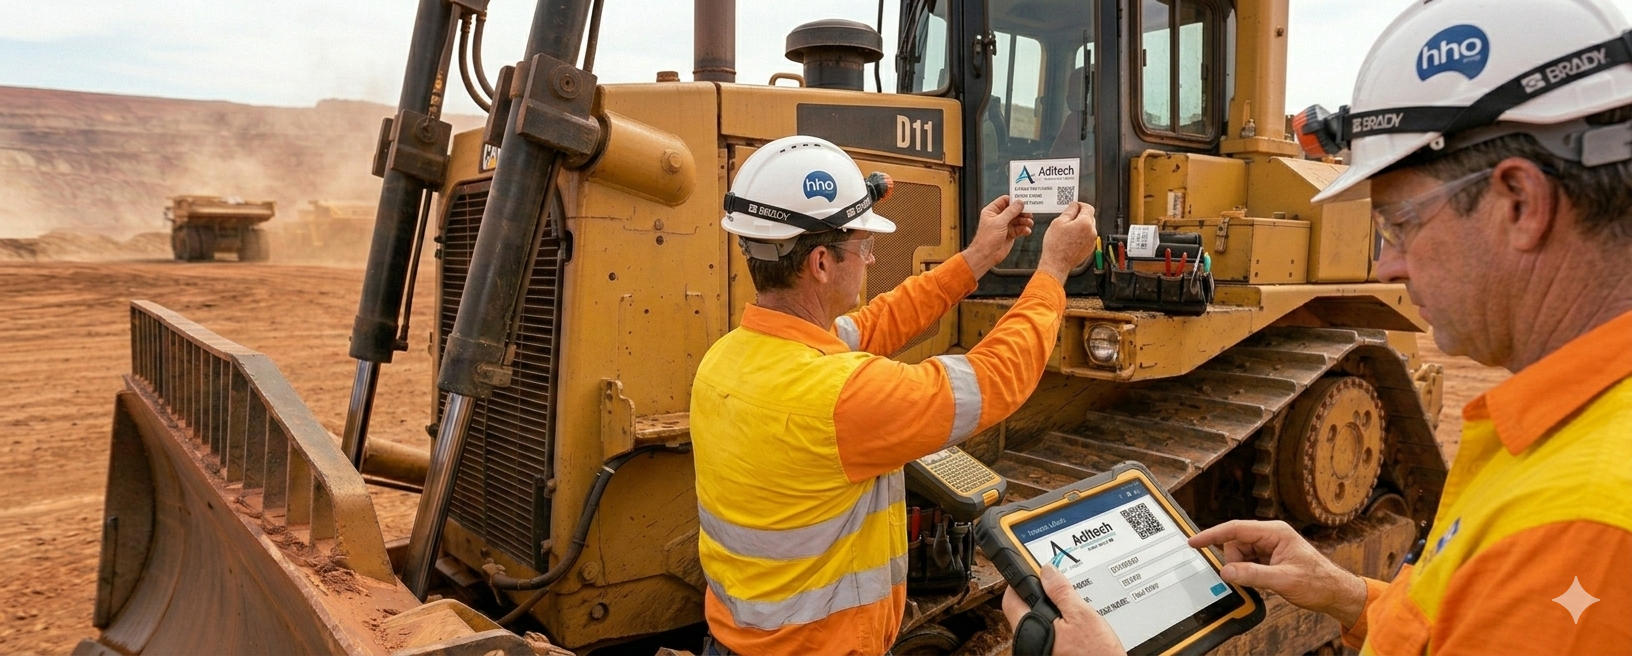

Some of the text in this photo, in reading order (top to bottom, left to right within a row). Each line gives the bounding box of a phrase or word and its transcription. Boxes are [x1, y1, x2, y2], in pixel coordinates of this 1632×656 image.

[1422, 37, 1481, 69] hho
[1546, 47, 1608, 83] BRADY
[896, 114, 933, 152] D11
[1362, 112, 1404, 129] BRADY
[482, 143, 502, 170] CA
[805, 178, 833, 191] hho
[1038, 165, 1074, 177] Aditech
